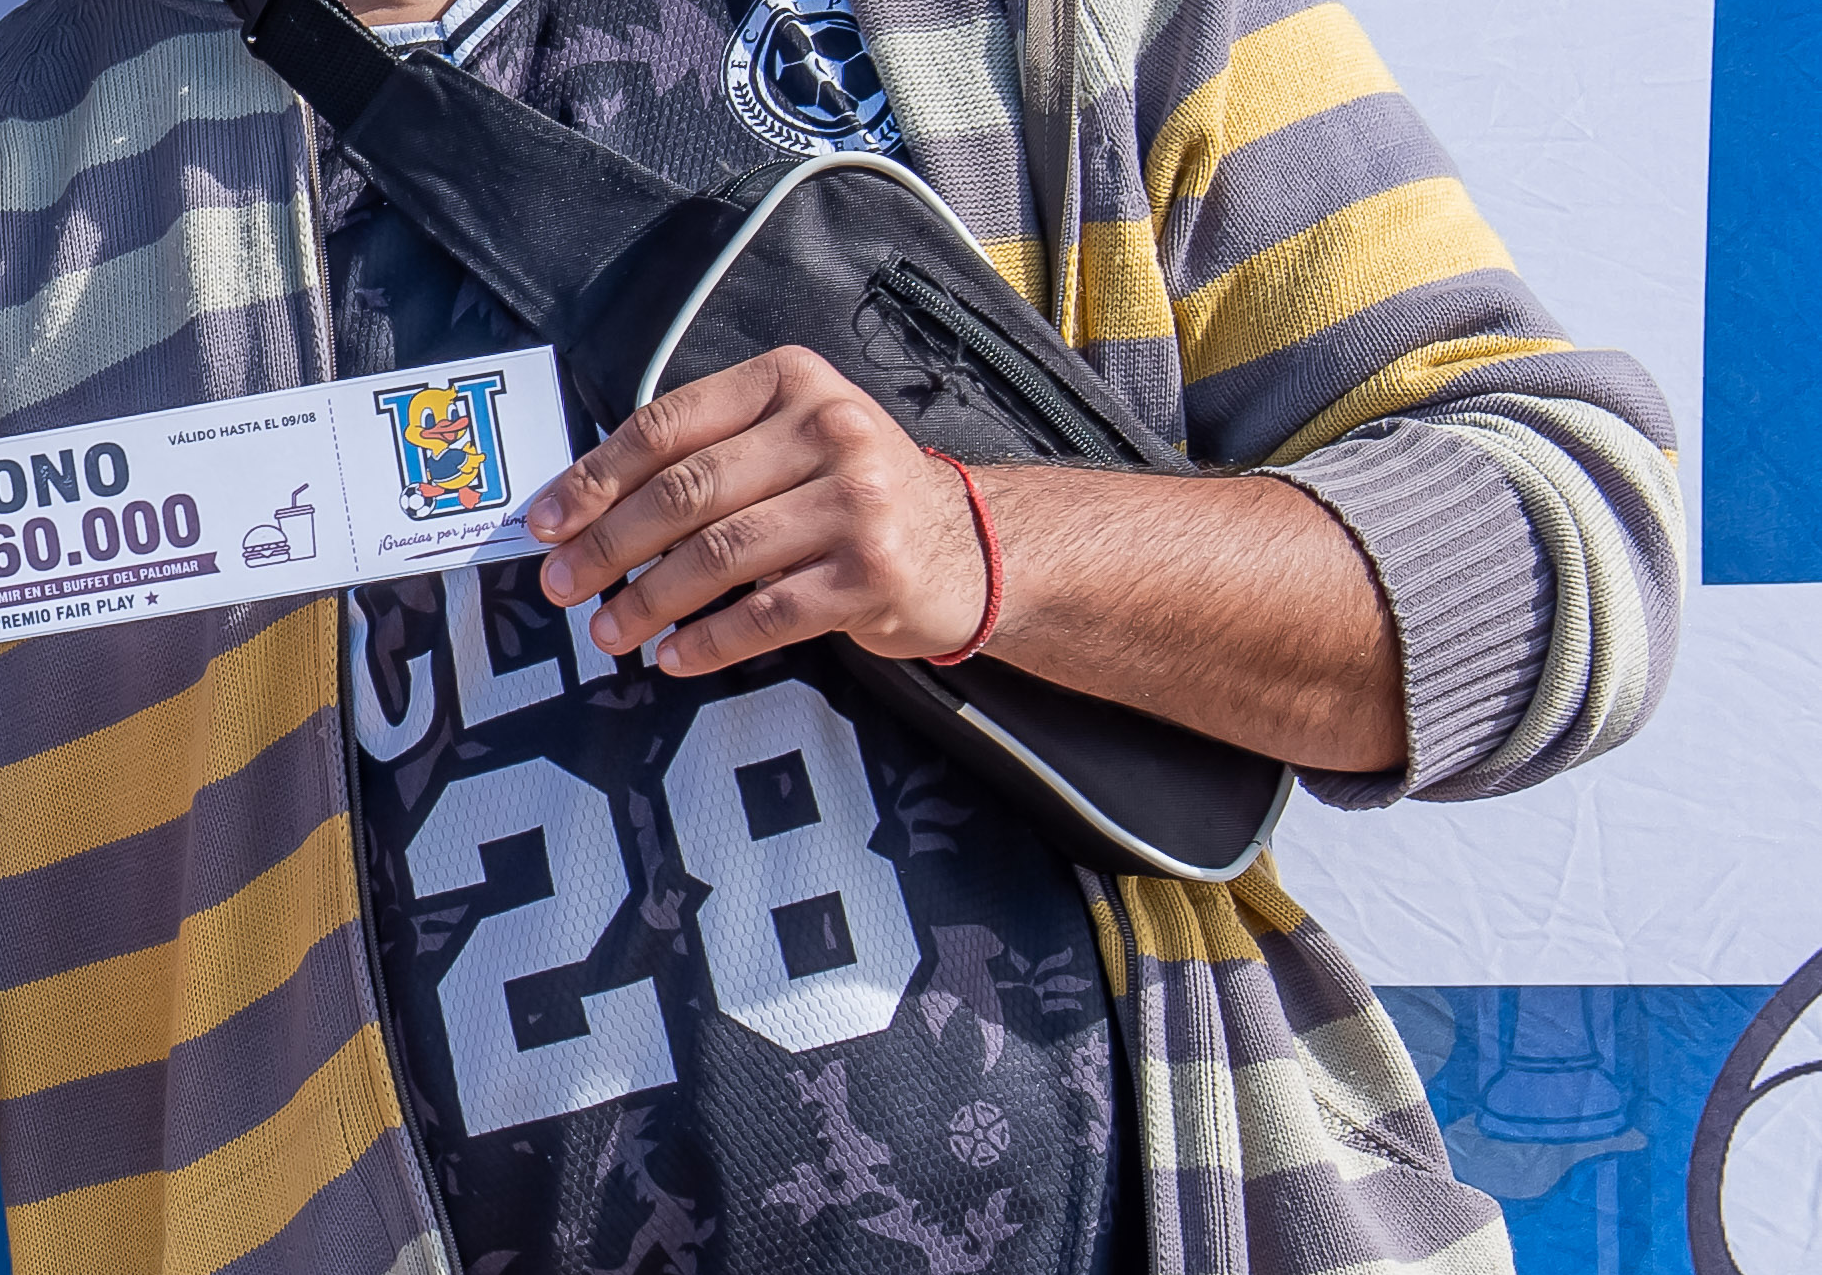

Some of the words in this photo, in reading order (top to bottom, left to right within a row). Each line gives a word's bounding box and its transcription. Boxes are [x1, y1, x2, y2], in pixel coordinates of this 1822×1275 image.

[168, 426, 216, 446] VÁLIDO
[219, 422, 262, 438] HASTA
[264, 419, 279, 430] EL
[281, 412, 317, 427] 09/08
[378, 532, 433, 556] ¡Gracias
[436, 529, 459, 544] por
[460, 520, 498, 540] jugar
[500, 512, 528, 528] limp
[24, 586, 42, 600] EN
[44, 583, 61, 596] EL
[62, 574, 110, 593] BUFFET
[113, 570, 137, 586] DEL
[139, 560, 199, 582] PALOMAR
[56, 601, 92, 622] FAIR
[97, 594, 136, 615] PLAY
[405, 678, 921, 1137] 28
